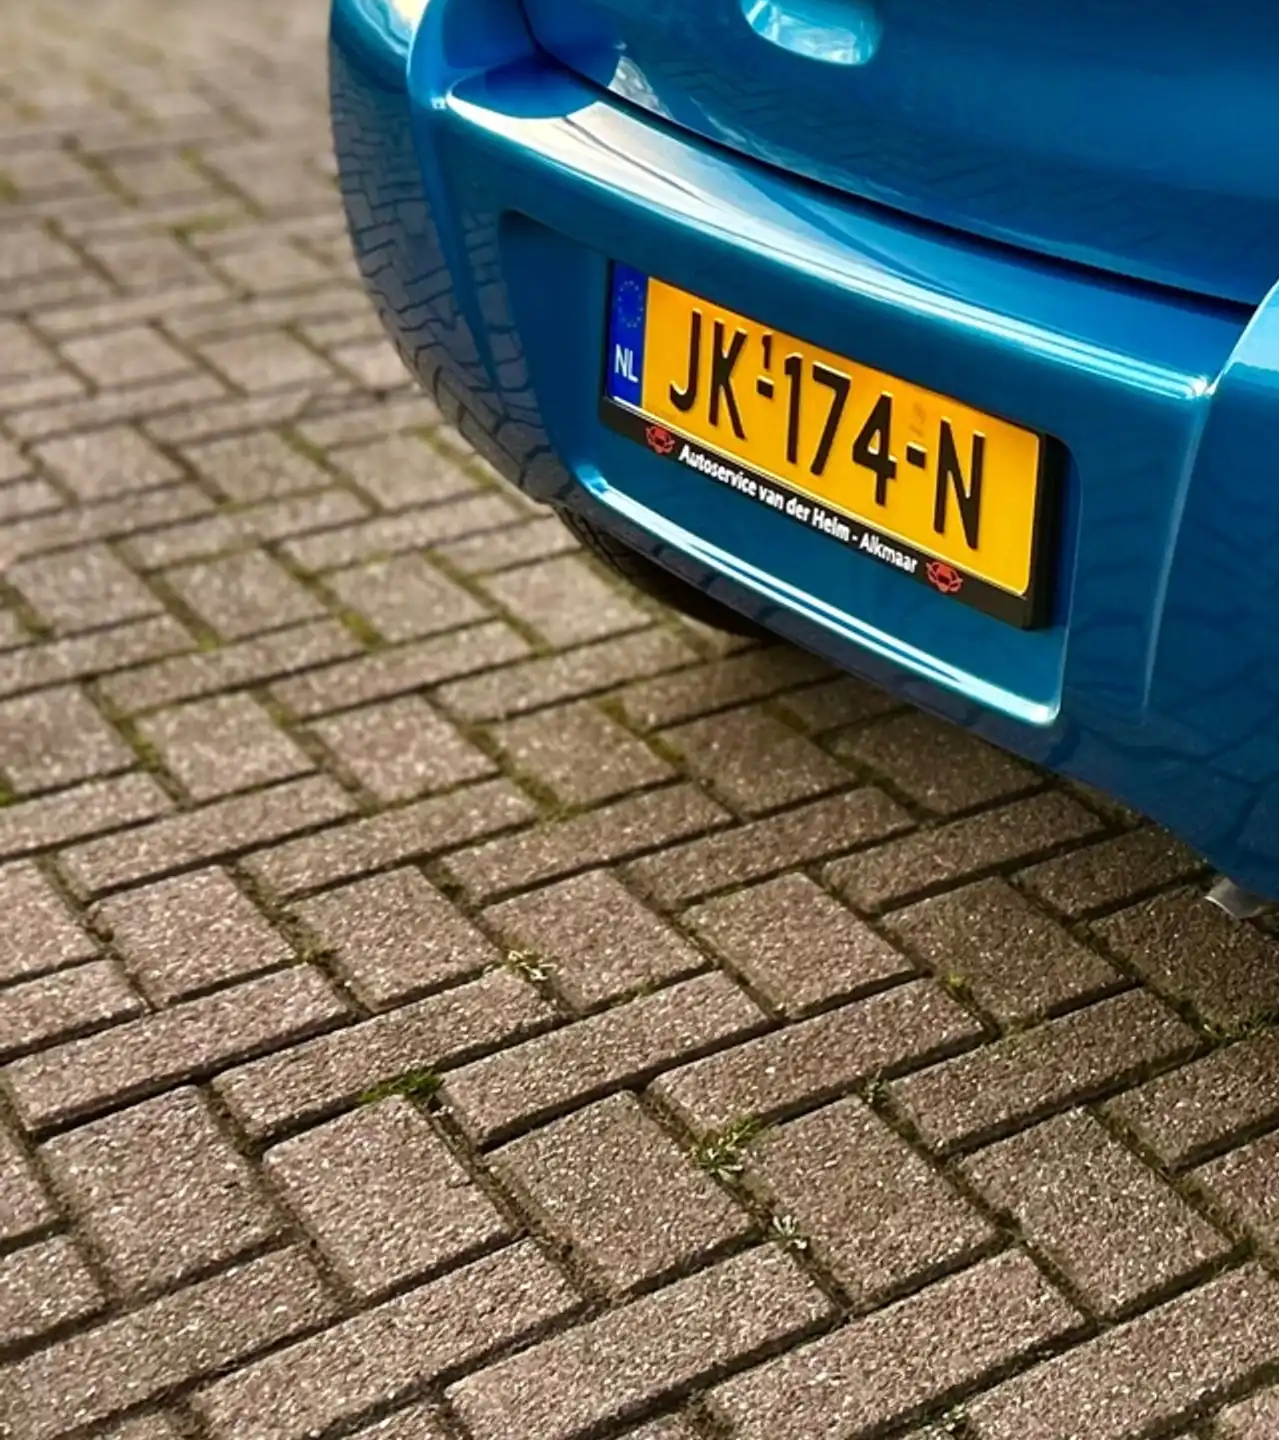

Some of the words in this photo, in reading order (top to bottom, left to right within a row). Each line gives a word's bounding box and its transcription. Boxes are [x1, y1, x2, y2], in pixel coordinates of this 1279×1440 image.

[614, 344, 639, 384] NL
[669, 308, 986, 549] JK-174-N
[678, 444, 757, 497] Autoservice
[758, 484, 784, 510] van
[786, 498, 811, 521] der
[859, 532, 918, 573] Alkmaar
